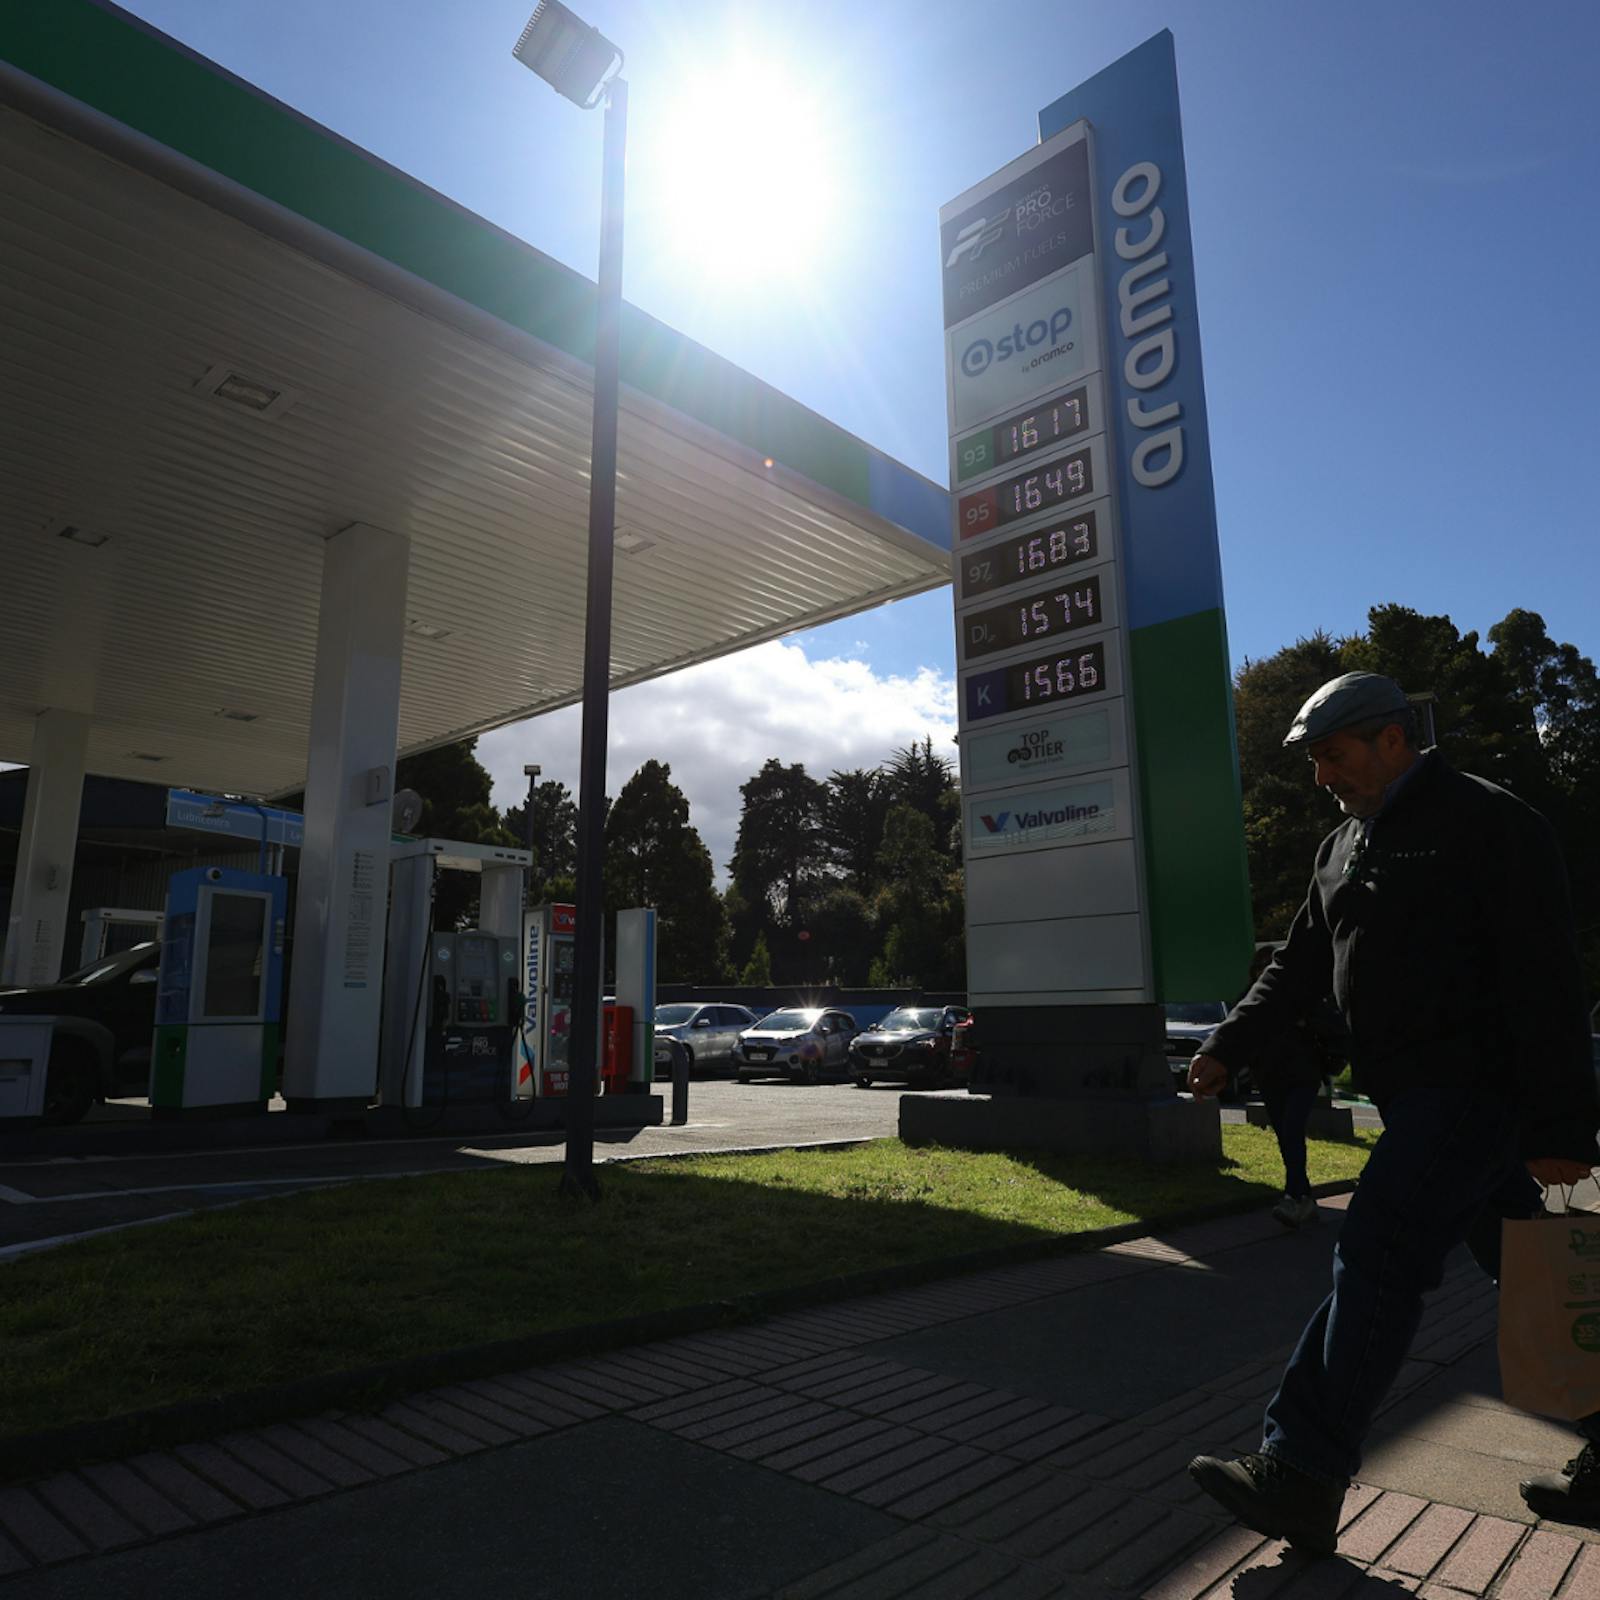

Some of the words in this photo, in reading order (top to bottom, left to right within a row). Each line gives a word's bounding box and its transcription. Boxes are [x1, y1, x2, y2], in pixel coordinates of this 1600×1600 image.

[1015, 191, 1052, 221] PRO
[1016, 192, 1076, 238] FORCE
[959, 256, 1022, 299] PREMIUM
[1023, 231, 1067, 265] FUELS
[997, 307, 1073, 362] stop
[1111, 161, 1183, 487] aramco
[1030, 341, 1075, 368] aramco
[963, 444, 986, 467] 93
[1012, 398, 1081, 453] 1617
[966, 503, 990, 526] 95
[1014, 459, 1085, 513] 1649
[968, 561, 992, 584] 97
[1018, 522, 1090, 574] 1683
[1020, 587, 1094, 636] 1574
[976, 684, 992, 707] K
[1024, 653, 1098, 700] 1566
[1019, 729, 1049, 746] TOP
[1031, 740, 1064, 759] TIER
[1014, 804, 1100, 829] Valvoline
[524, 924, 541, 1036] Valvoline
